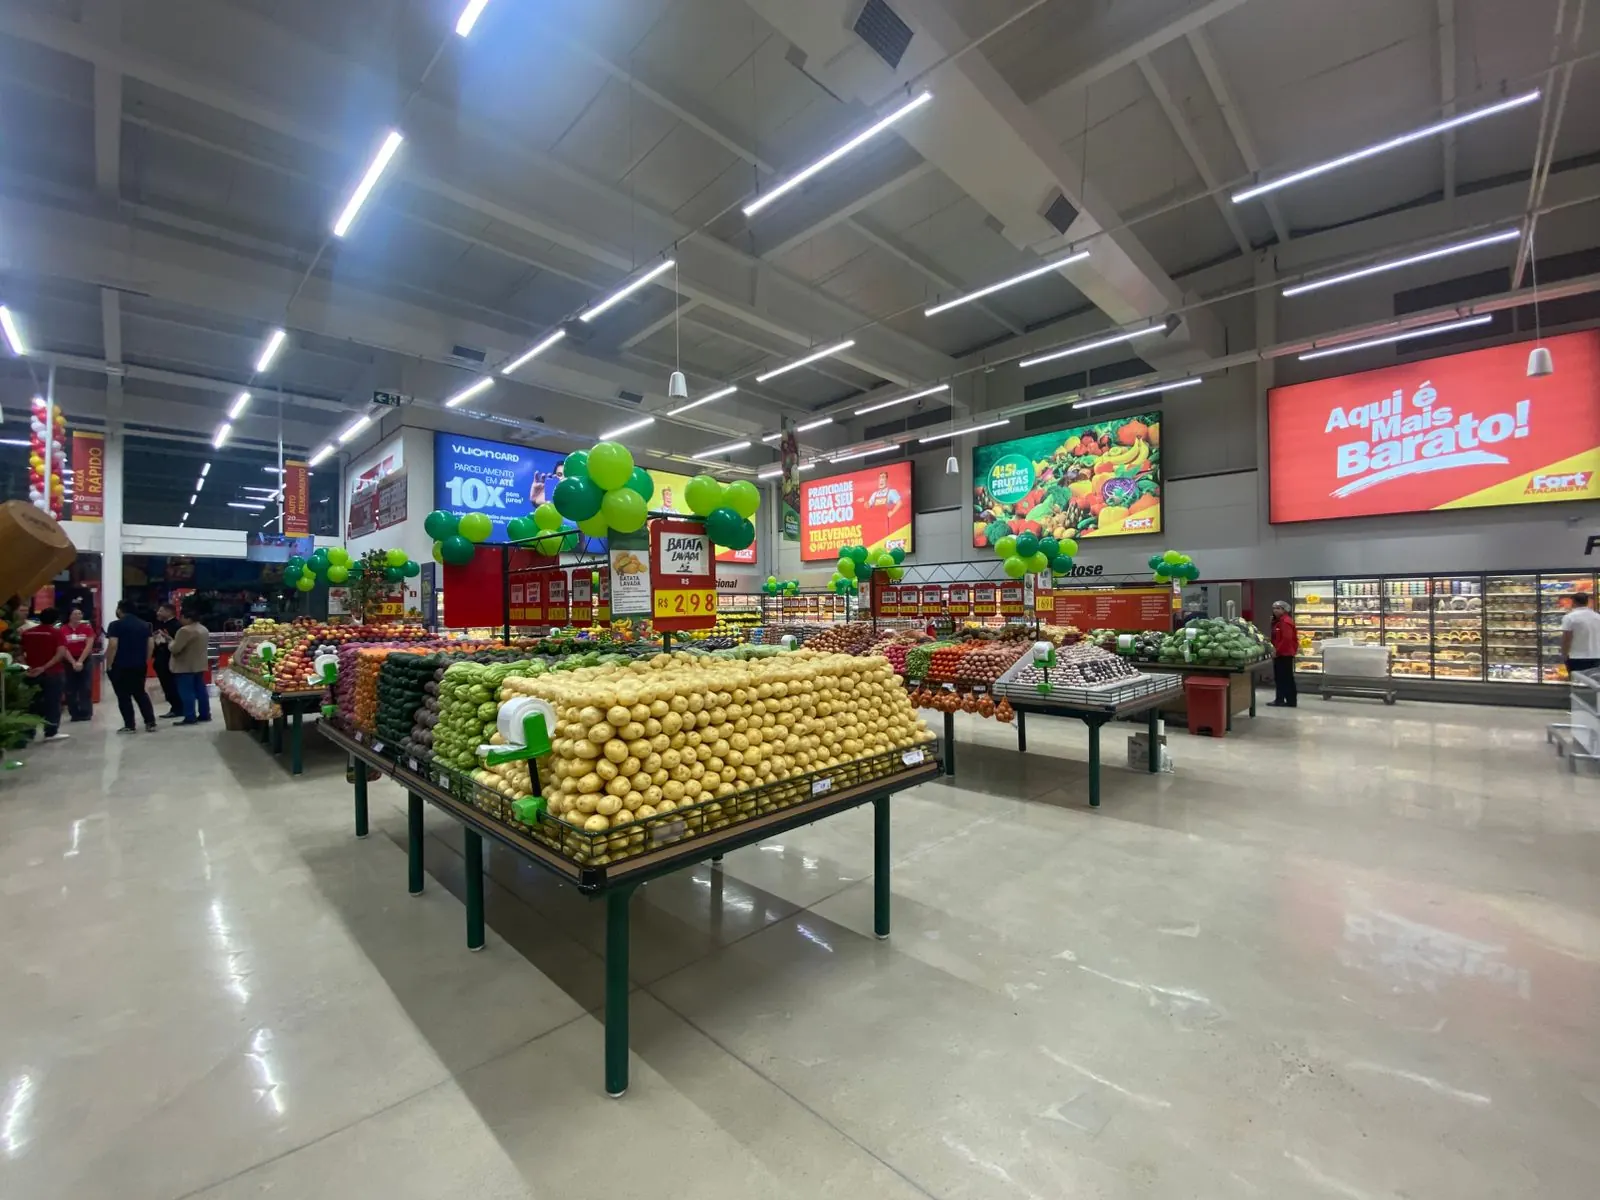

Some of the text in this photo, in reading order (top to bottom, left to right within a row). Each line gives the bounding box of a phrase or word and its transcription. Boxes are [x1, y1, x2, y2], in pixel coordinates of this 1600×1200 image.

[1325, 380, 1437, 433] Aqui é
[1372, 407, 1452, 442] Mais
[1336, 400, 1530, 479] Barato!
[86, 447, 102, 493] RÁPIDO
[454, 463, 515, 478] PARCELAMENTO
[76, 469, 84, 492] CAIXA
[486, 477, 514, 487] EM ATÉ
[808, 481, 853, 497] PRATICIDADE
[992, 475, 1028, 489] FRUTAS
[1533, 472, 1585, 490] Fort
[808, 491, 853, 511] PARA SEU
[809, 505, 853, 526] NEGÓCIO
[809, 525, 862, 543] TELEVENDAS
[665, 538, 703, 552] BATATA
[671, 550, 699, 562] LAVADA
[658, 598, 668, 609] R$
